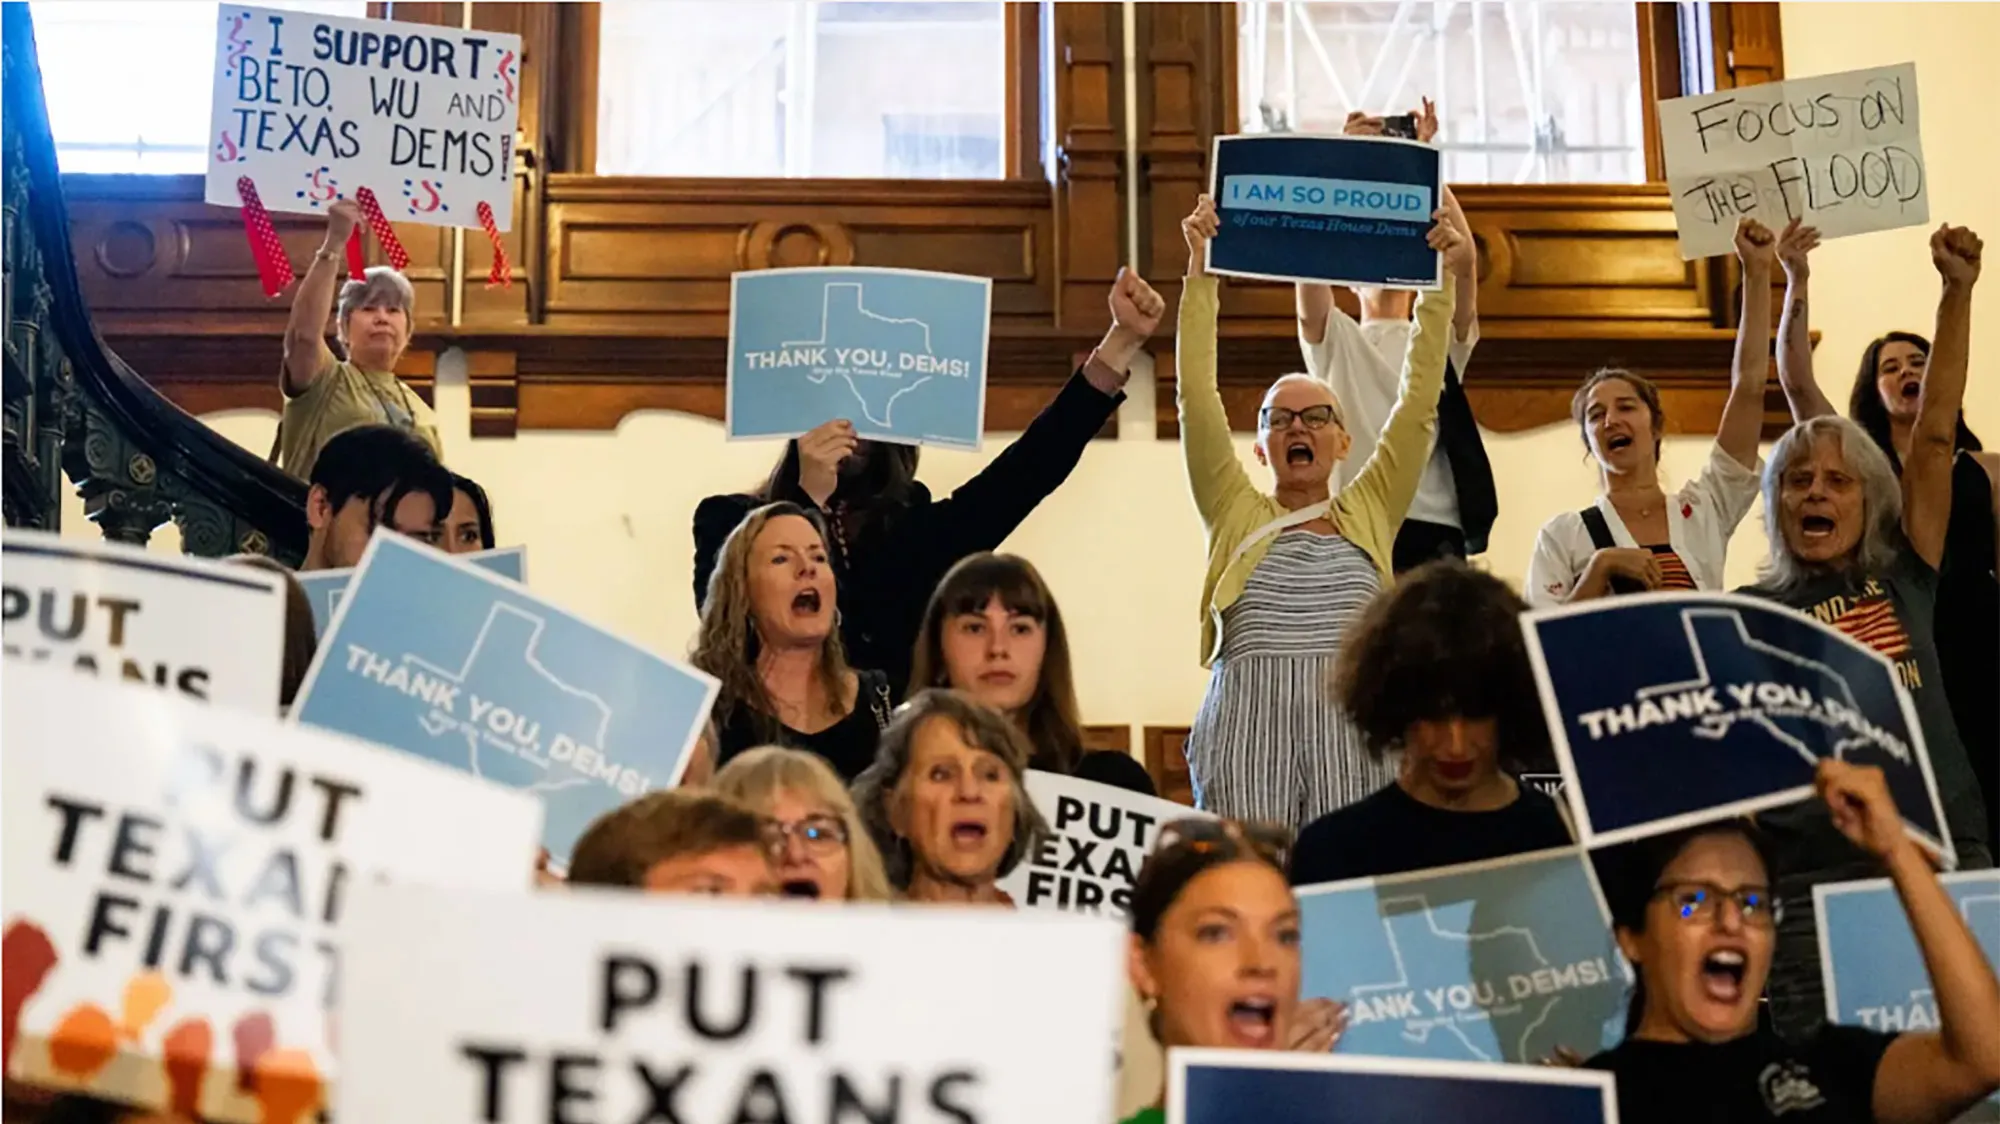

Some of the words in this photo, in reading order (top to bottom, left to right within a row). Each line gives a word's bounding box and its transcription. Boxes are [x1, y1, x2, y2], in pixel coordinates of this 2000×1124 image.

[268, 15, 284, 56] I
[313, 23, 489, 80] SUPPORT
[369, 76, 420, 119] WU
[447, 92, 506, 121] AND
[1691, 93, 1840, 154] FOCUS
[1859, 75, 1905, 130] ON
[232, 108, 360, 159] TEXAS
[390, 123, 511, 181] DEMS!
[1232, 184, 1239, 199] I
[1246, 183, 1284, 202] AM
[1292, 185, 1325, 204] SO
[1333, 188, 1422, 211] PROUD
[1681, 178, 1758, 226] THE
[1766, 145, 1922, 222] FLOOD
[1280, 214, 1324, 231] Texas
[1325, 219, 1374, 235] House
[1375, 222, 1419, 237] Dems
[744, 347, 828, 370] THANK
[835, 347, 893, 371] YOU,
[899, 351, 970, 379] DEMS!
[2, 585, 142, 648] PUT
[345, 642, 462, 713] THANK
[467, 692, 542, 752] YOU,
[1577, 686, 1725, 740] THANK
[1056, 794, 1156, 848] PUT
[45, 791, 348, 925] TEXA
[1031, 834, 1138, 888] EXA
[1027, 870, 1136, 919] FIRS
[598, 952, 856, 1043] PUT
[1343, 989, 1422, 1026] ANK
[1507, 956, 1611, 1000] DEMS!
[1855, 1001, 1941, 1034] THA
[457, 1043, 981, 1124] TEXANS
